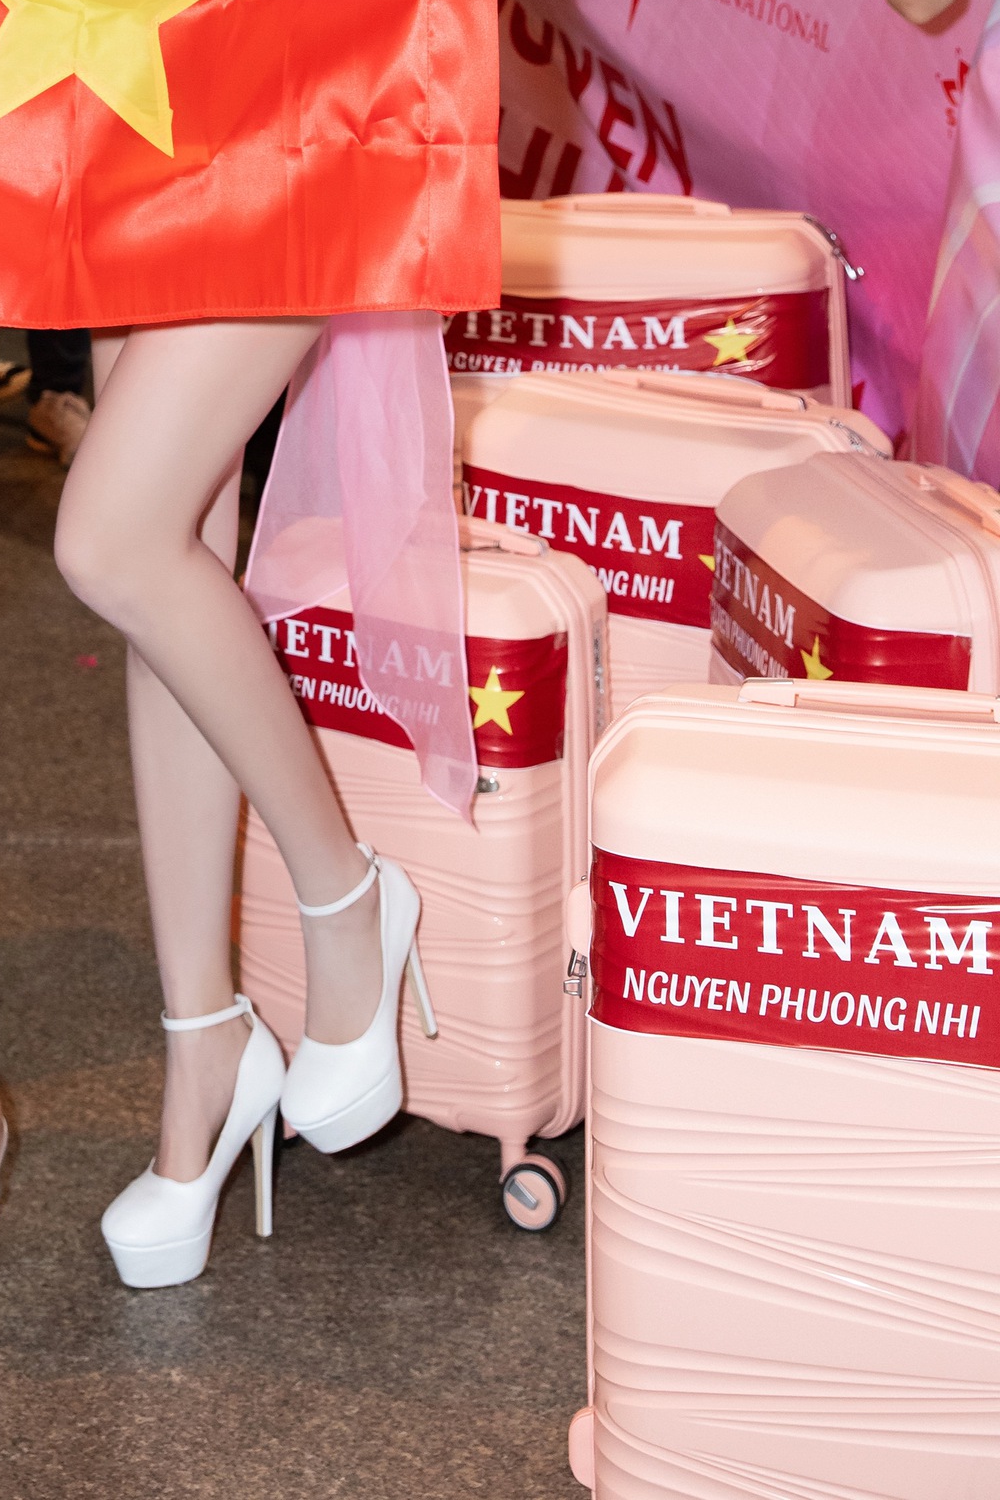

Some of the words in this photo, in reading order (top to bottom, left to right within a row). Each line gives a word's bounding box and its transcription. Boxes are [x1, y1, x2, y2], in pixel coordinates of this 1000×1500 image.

[631, 573, 675, 603] NHI
[715, 536, 796, 649] IETNAM
[268, 617, 454, 688] IETNAM
[319, 680, 399, 718] PHUONG
[608, 881, 993, 975] VIETNAM
[623, 967, 751, 1014] NGUYEN
[758, 984, 907, 1032] PHUONG
[914, 1000, 981, 1039] NHI
